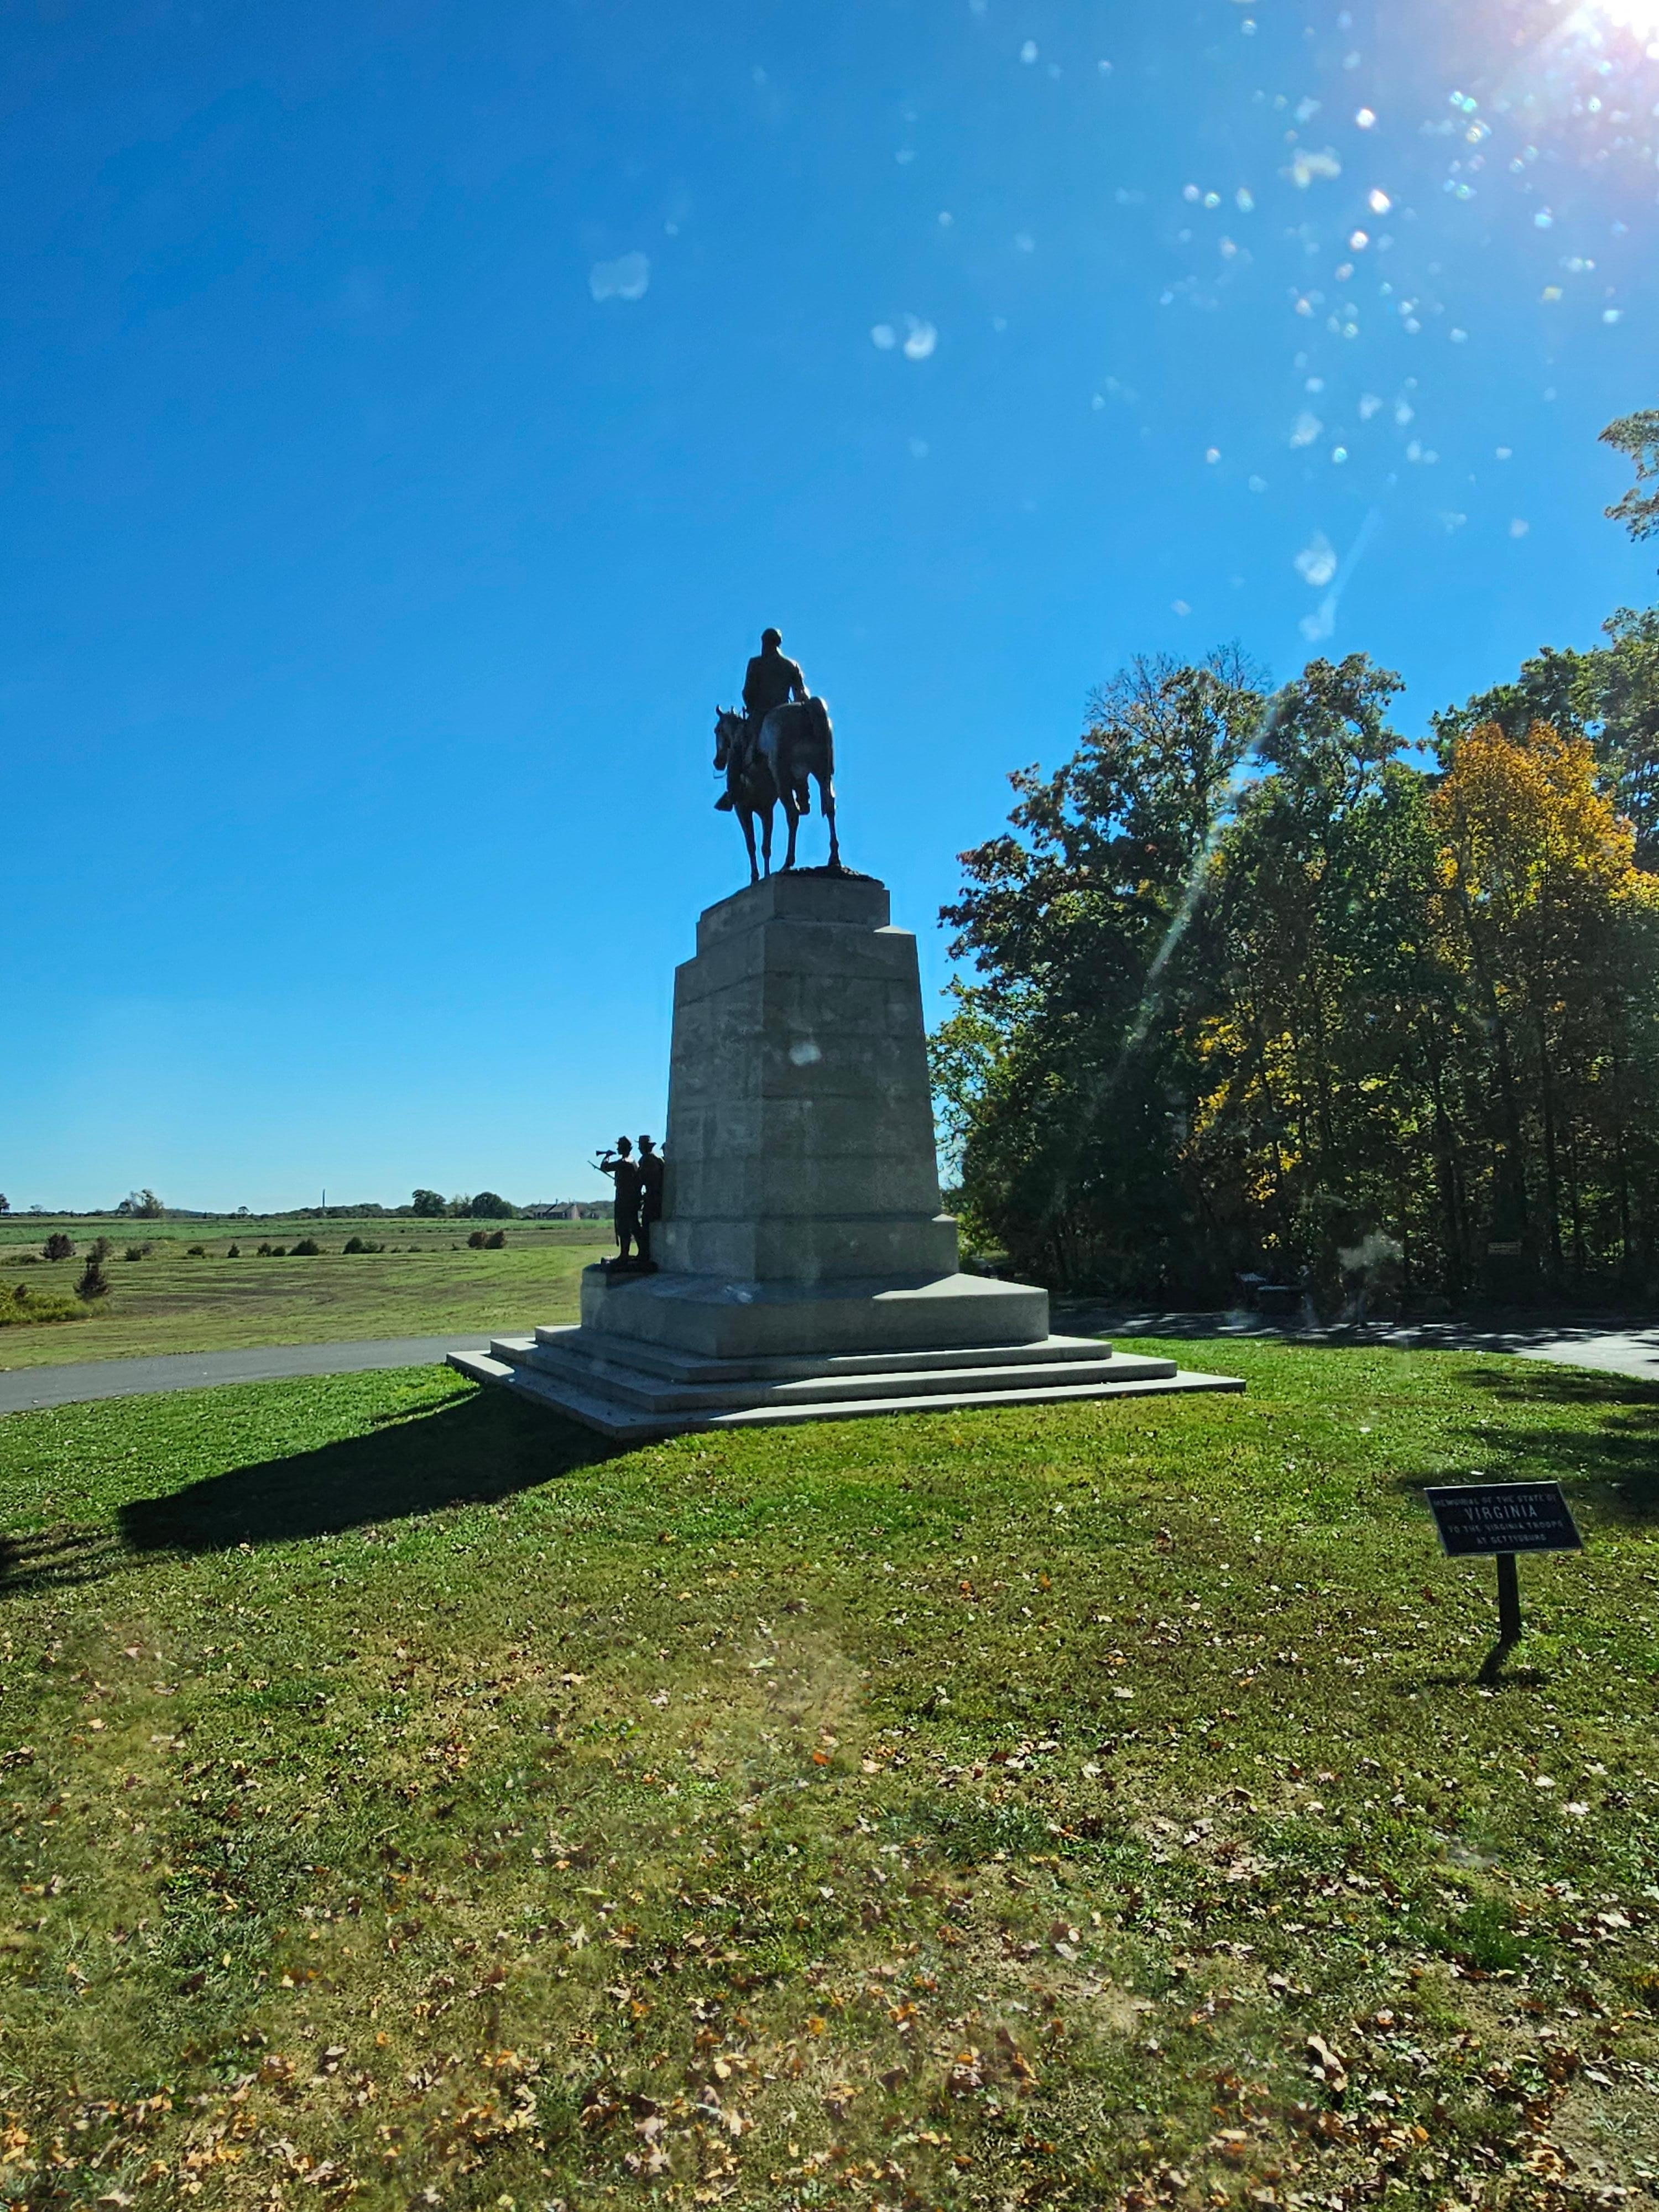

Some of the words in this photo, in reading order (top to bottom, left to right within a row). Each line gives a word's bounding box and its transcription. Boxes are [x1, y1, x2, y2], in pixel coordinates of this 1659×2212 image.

[1495, 1495, 1515, 1504] THE
[1517, 1494, 1544, 1503] STATE
[1464, 1504, 1537, 1521] VIRGINIA
[1447, 1525, 1460, 1533] TO
[1461, 1524, 1481, 1533] THE
[1484, 1522, 1525, 1531] VIRGINIA
[1526, 1520, 1564, 1530] TROOPS
[1477, 1536, 1488, 1545] AT
[1490, 1533, 1547, 1544] GETTYSBURG
